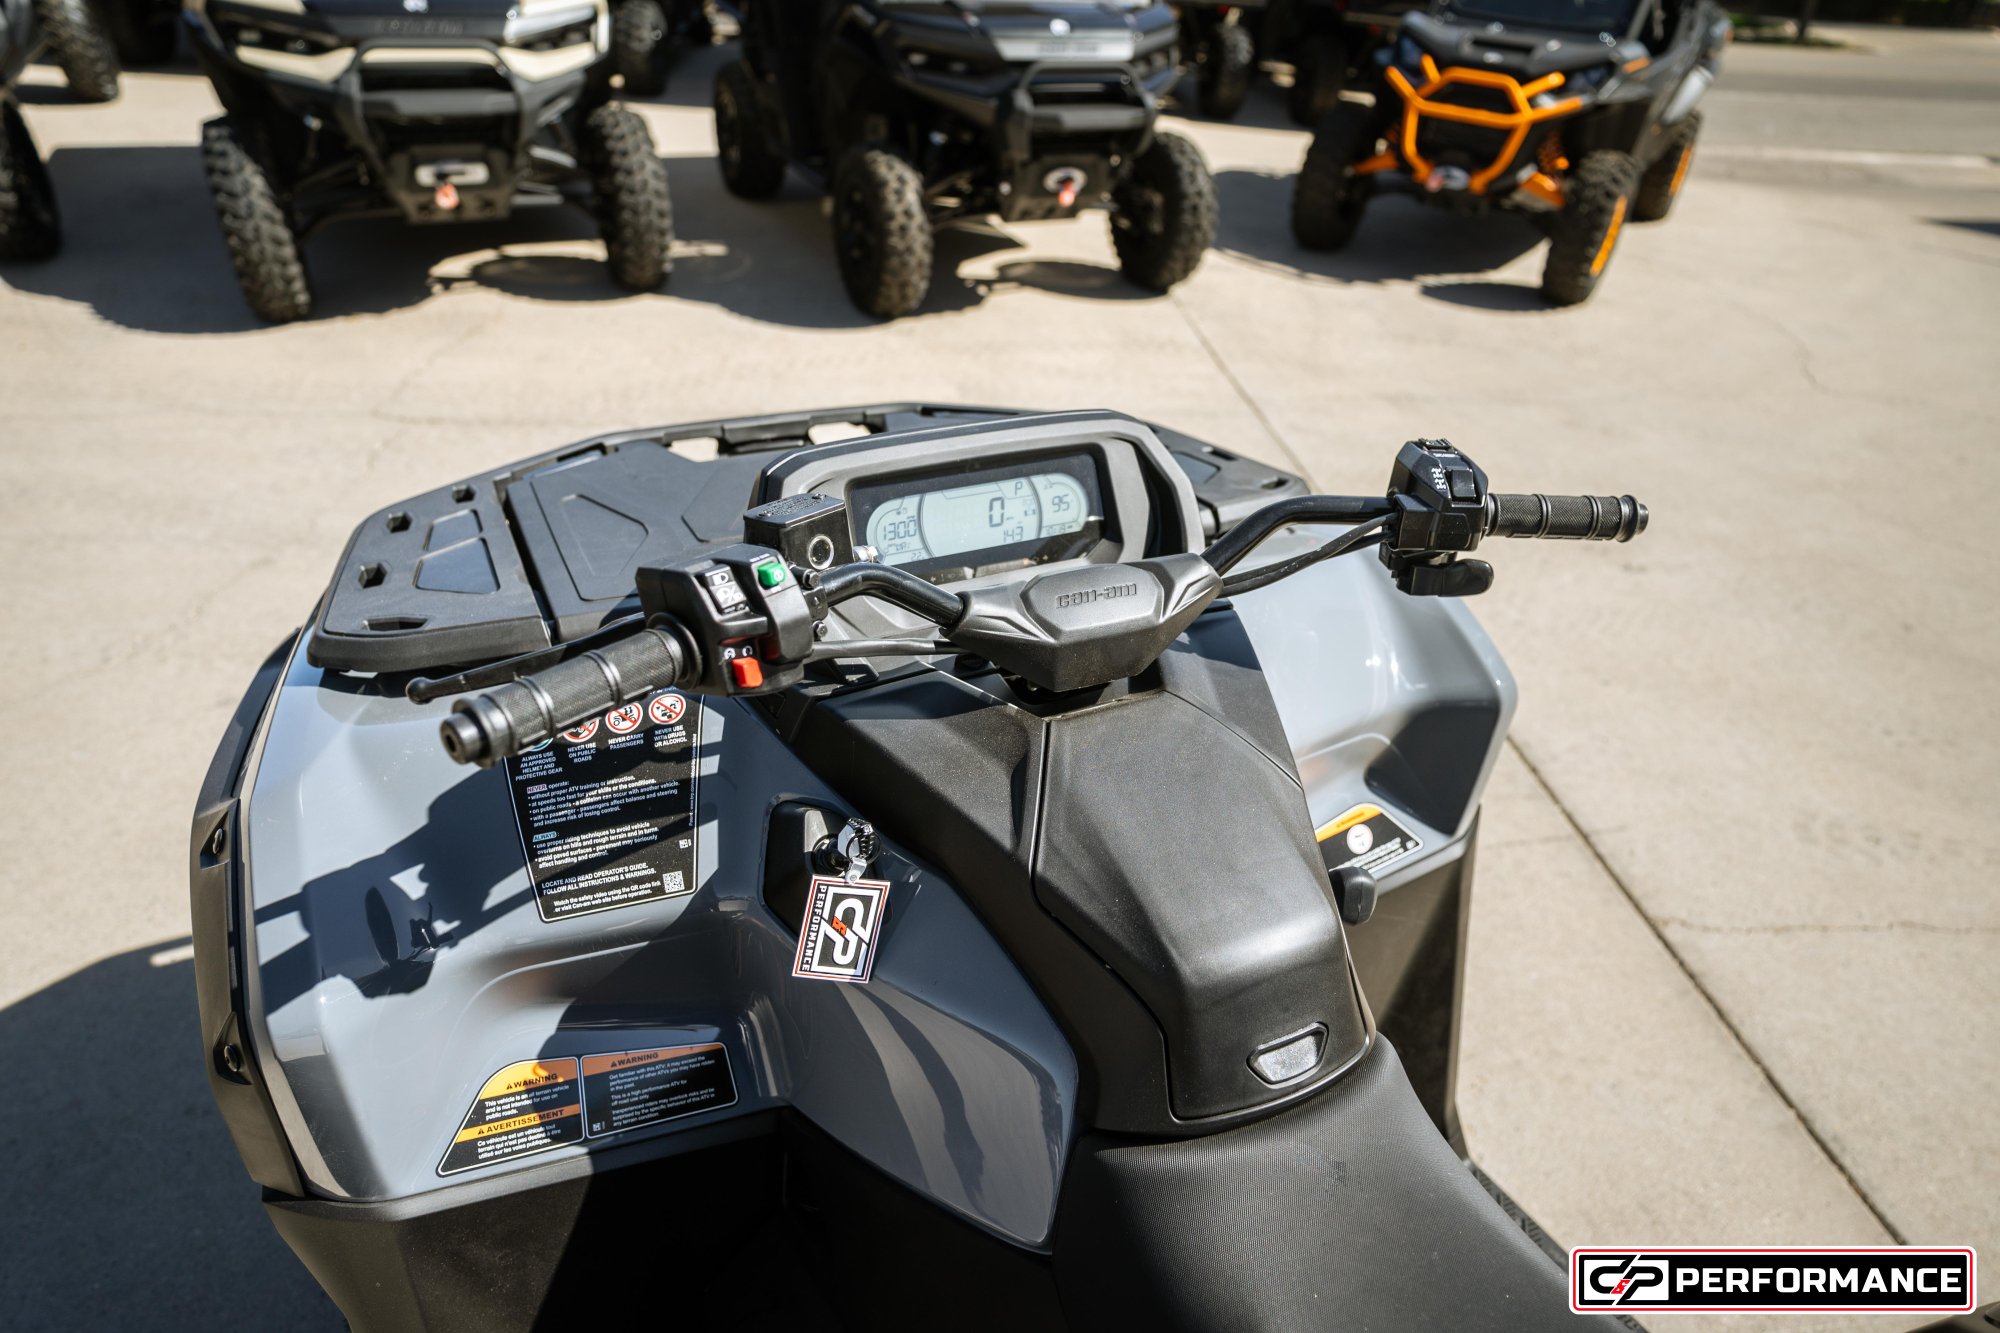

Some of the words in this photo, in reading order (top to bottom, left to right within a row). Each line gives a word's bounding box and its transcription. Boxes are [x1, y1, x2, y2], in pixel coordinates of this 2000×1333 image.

[1052, 494, 1069, 512] 95
[989, 496, 1005, 527] 0
[884, 519, 917, 541] 1300
[1004, 526, 1023, 543] 143
[1056, 583, 1137, 608] can-am
[608, 737, 626, 745] NEVER
[626, 733, 644, 741] CARRY
[610, 740, 644, 750] PASSENGERS
[522, 753, 542, 762] ALWAYS
[578, 749, 596, 757] PUBLIC
[528, 757, 556, 766] APPROVED
[516, 771, 547, 781] PROTECTIVE
[548, 767, 562, 775] GEAR
[523, 765, 542, 773] HELMET
[538, 798, 556, 807] speeds
[628, 779, 656, 787] conditions.
[580, 796, 601, 804] collision
[550, 808, 575, 819] passenger
[580, 802, 609, 812] passengers
[545, 817, 566, 825] increase
[538, 847, 562, 855] overturns
[594, 836, 609, 844] rough
[547, 840, 564, 848] proper
[581, 830, 609, 840] techniques
[554, 851, 569, 860] paved
[570, 847, 592, 855] surfaces
[596, 841, 621, 852] pavement
[634, 834, 657, 843] seriously
[555, 857, 577, 865] handling
[542, 880, 564, 888] LOCATE
[594, 866, 628, 877] OPERATOR'S
[630, 863, 648, 871] GUIDE.
[543, 887, 566, 895] FOLLOW
[579, 877, 619, 888] INSTRUCTIONS
[625, 868, 656, 878] WARNINGS.
[802, 885, 827, 971] PERFORMANCE
[618, 1052, 658, 1065] WARNING
[514, 1074, 558, 1088] WARNING
[498, 1097, 514, 1105] vehicle
[512, 1100, 532, 1108] intended
[486, 1113, 501, 1121] public
[487, 1110, 564, 1133] AVERTISSEMENT
